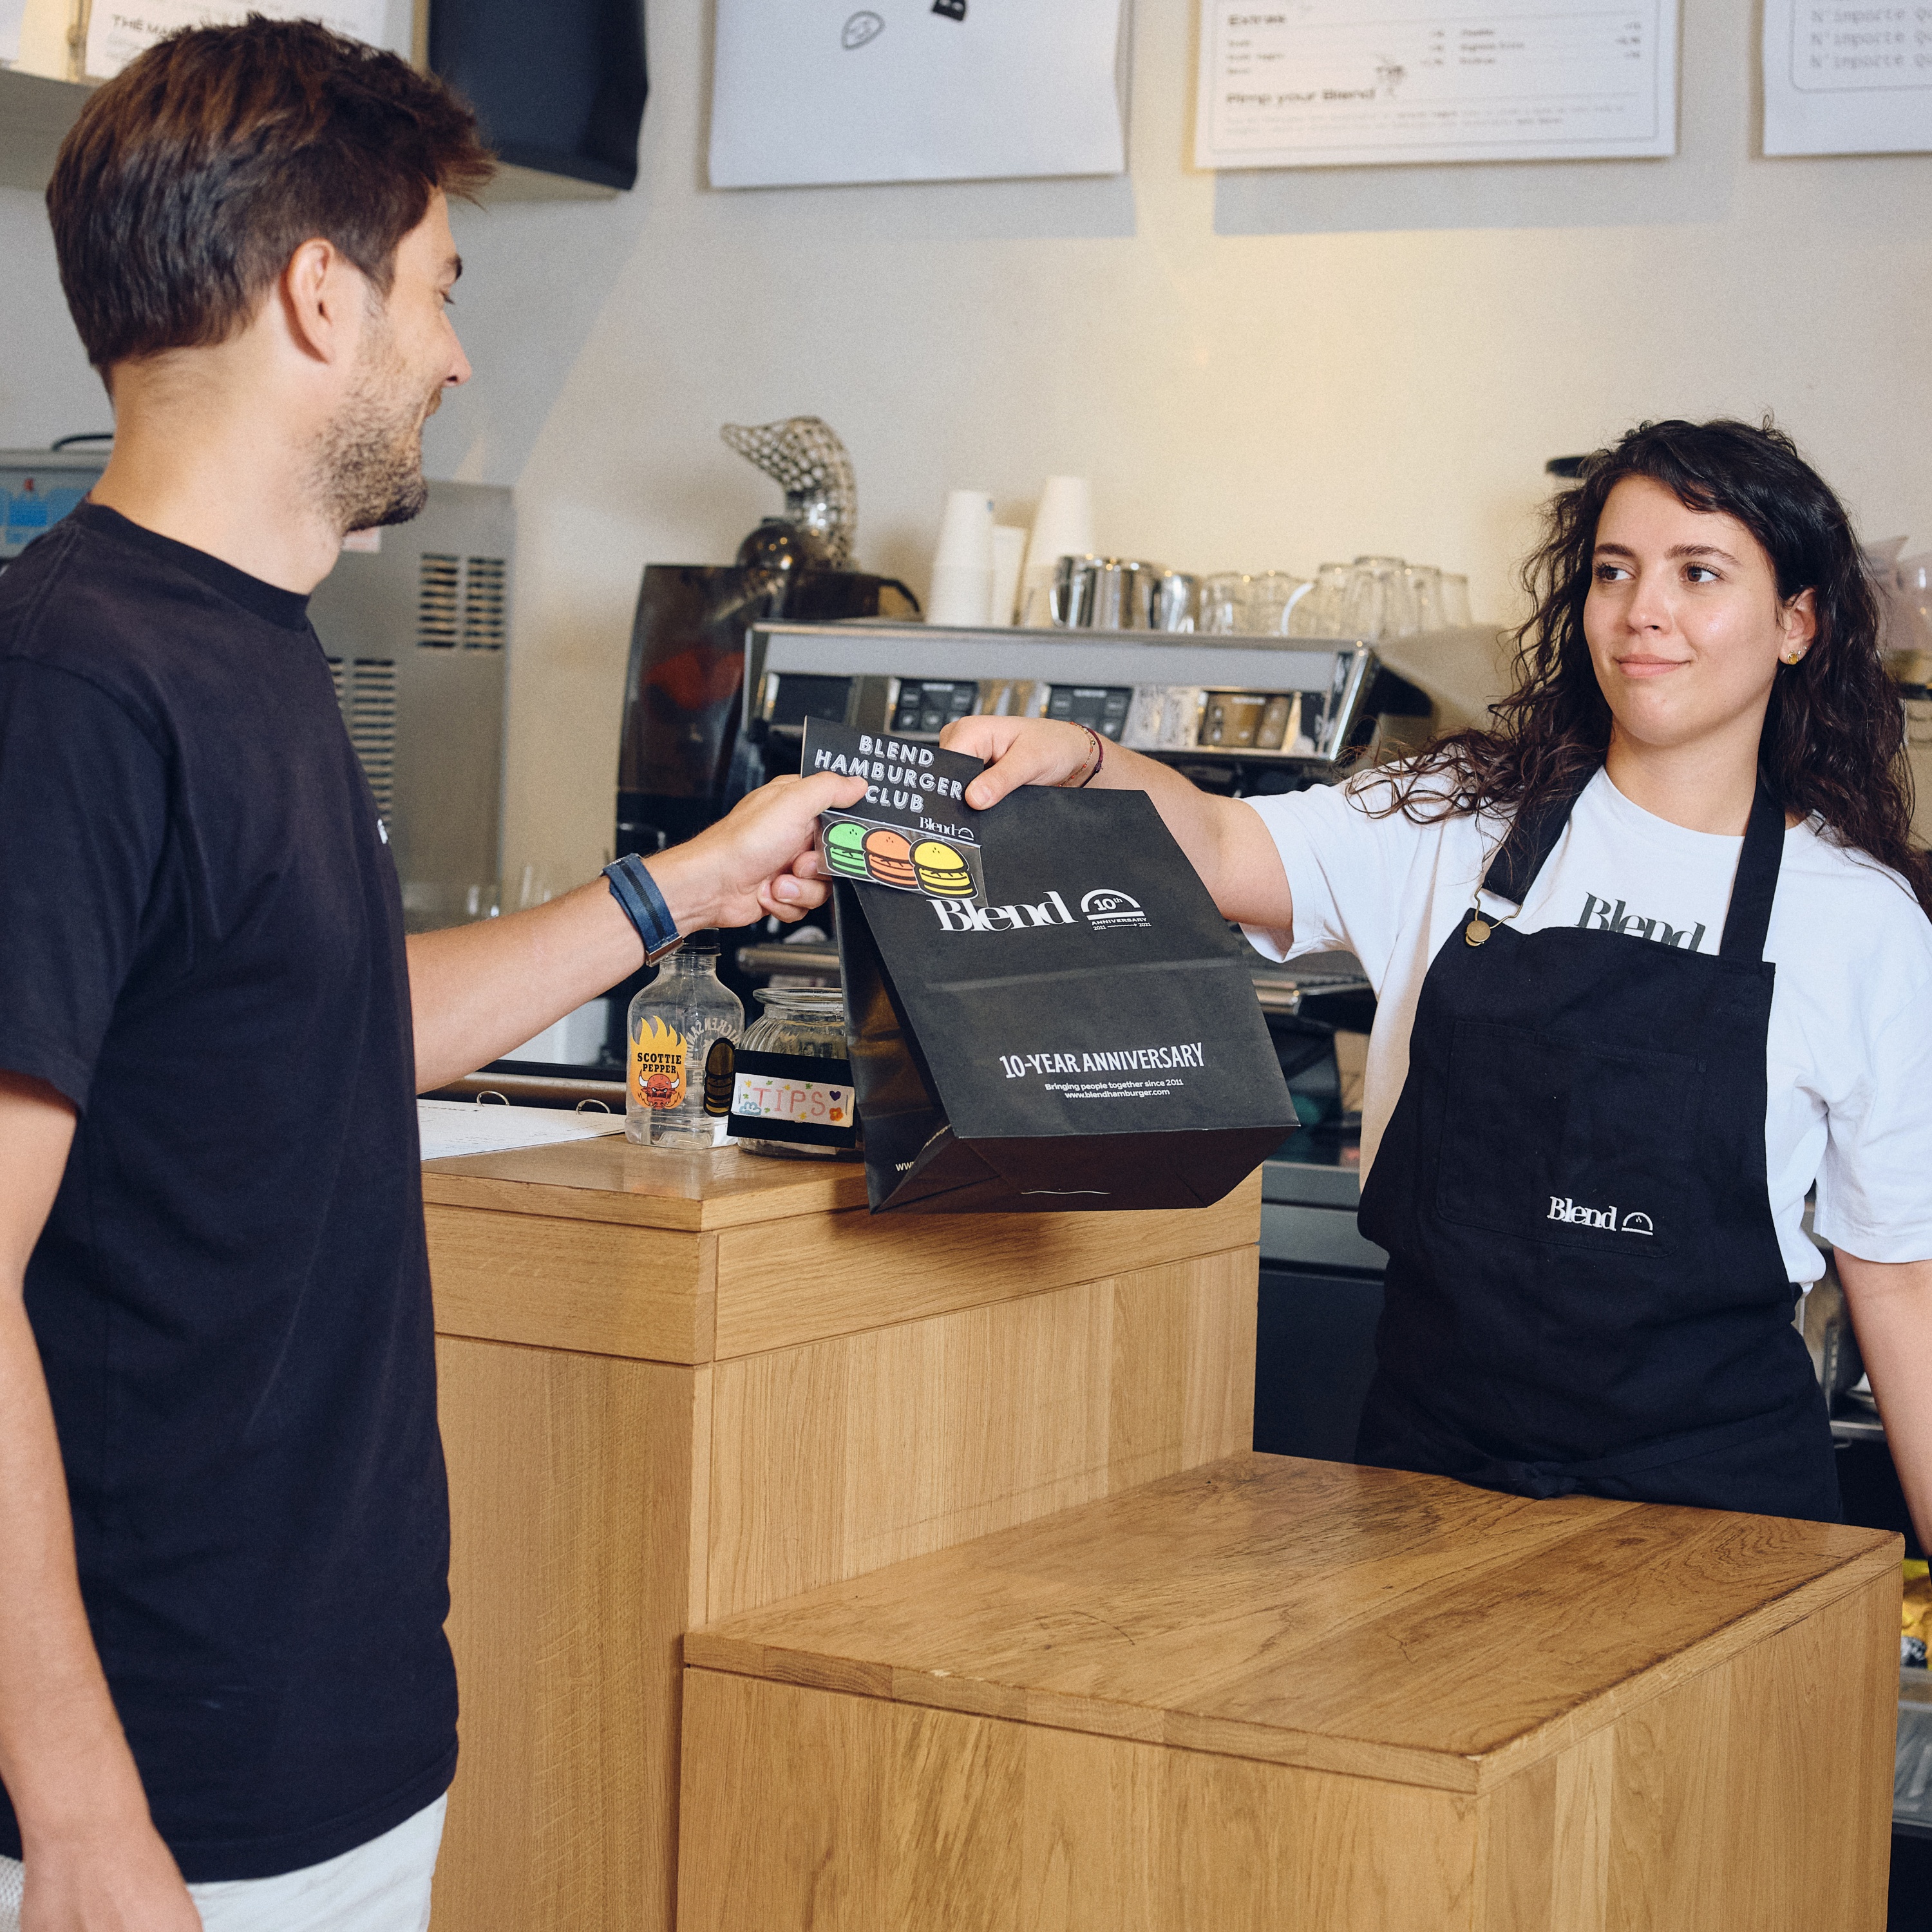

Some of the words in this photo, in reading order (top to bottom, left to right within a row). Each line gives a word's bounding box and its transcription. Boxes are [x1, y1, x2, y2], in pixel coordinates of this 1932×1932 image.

[859, 735, 934, 768] BLEND
[815, 749, 963, 800] HAMBURGER
[865, 785, 924, 813] CLUB
[920, 816, 955, 836] Blend
[926, 891, 1079, 931] Blend
[1094, 897, 1123, 911] 10th
[638, 1052, 682, 1065] SCOTTIE
[643, 1064, 676, 1074] PEPPER
[999, 1053, 1081, 1079] 10-YEAR
[1083, 1042, 1204, 1072] ANNIVERSARY
[1045, 1083, 1080, 1092] Bringing
[1081, 1082, 1108, 1090] people
[1108, 1080, 1143, 1089] together
[1065, 1088, 1170, 1099] www.blendhamburger.com
[753, 1088, 826, 1116] TIPS
[1547, 1196, 1616, 1231] Blend
